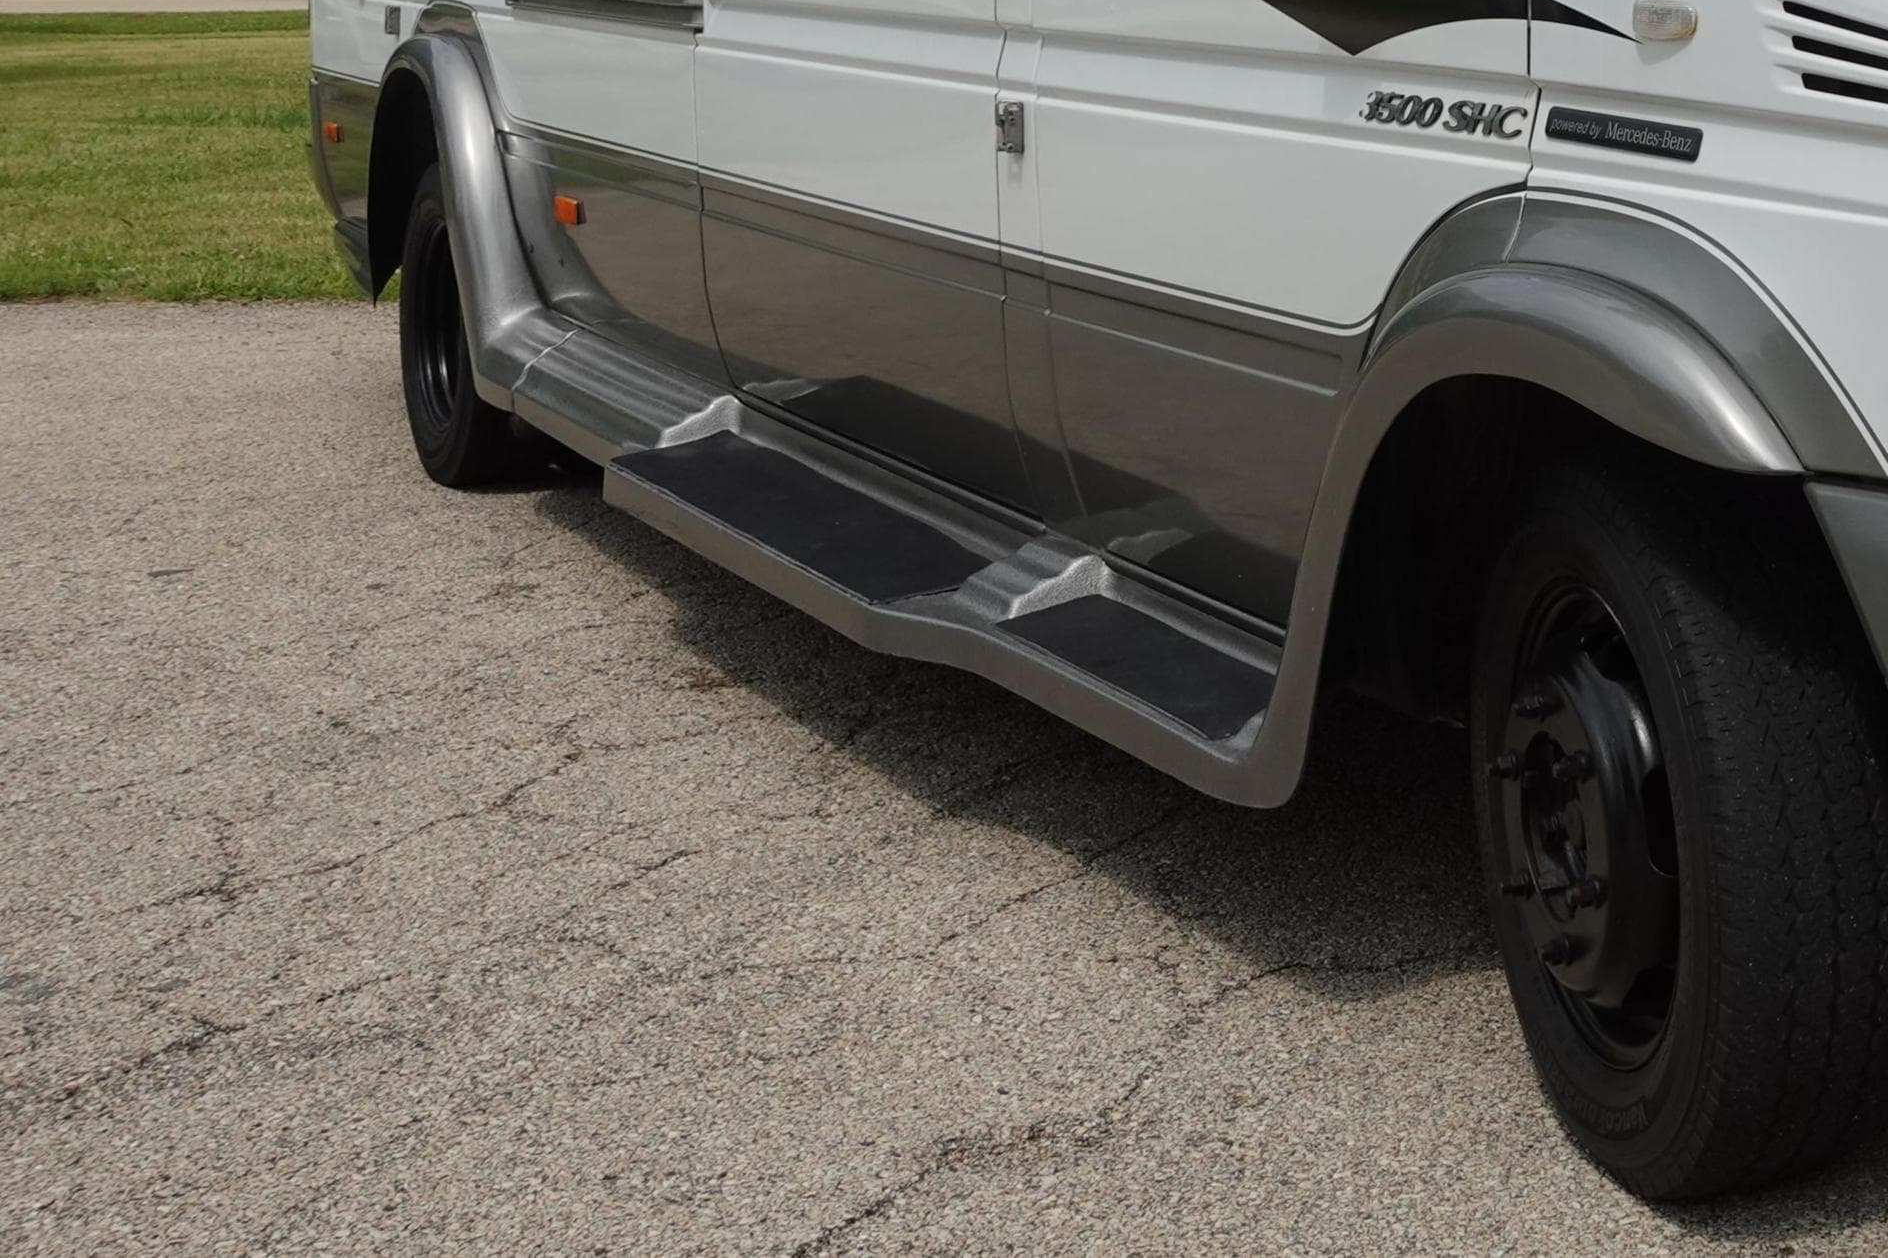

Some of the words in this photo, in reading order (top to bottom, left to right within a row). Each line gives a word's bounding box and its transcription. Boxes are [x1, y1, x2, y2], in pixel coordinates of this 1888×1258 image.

[1359, 90, 1444, 129] 3500
[1442, 99, 1528, 140] SHC
[1550, 118, 1590, 134] powered
[1589, 122, 1601, 139] by
[1604, 120, 1693, 152] Mercedes-Benz
